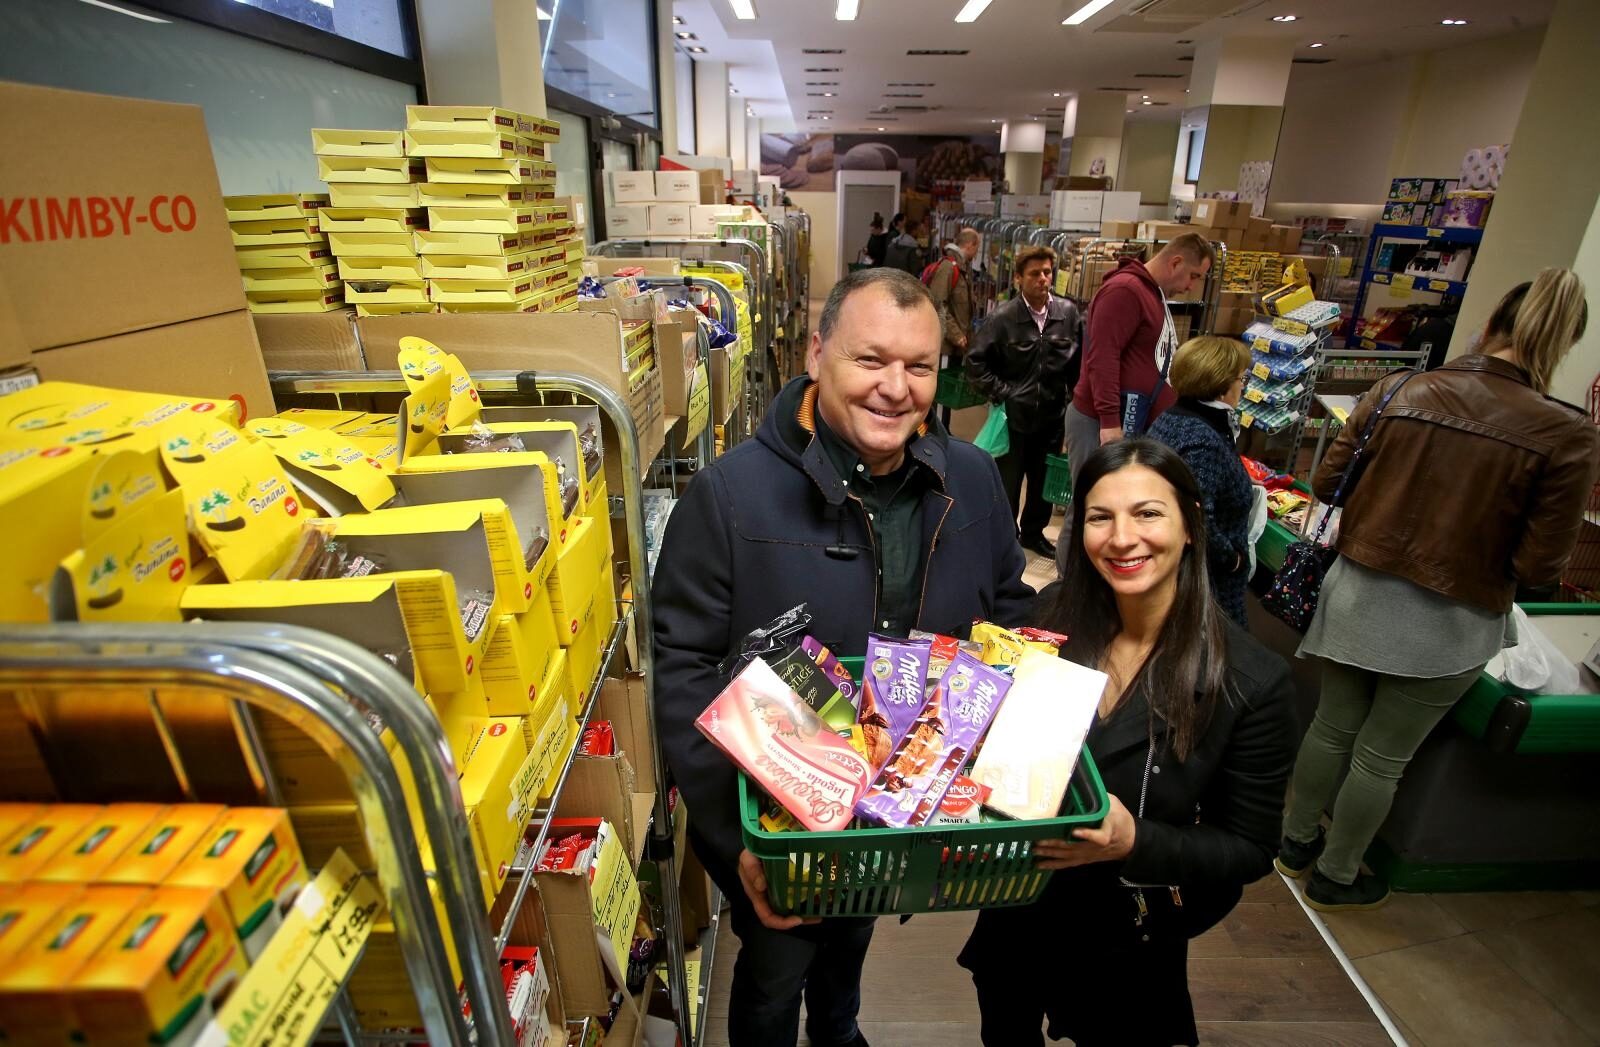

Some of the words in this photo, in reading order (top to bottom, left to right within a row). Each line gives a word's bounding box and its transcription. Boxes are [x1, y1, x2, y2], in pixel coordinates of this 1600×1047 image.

[0, 194, 197, 244] KIMBY-CO
[248, 484, 288, 514] Banana
[133, 545, 180, 583] Banana
[789, 664, 814, 690] STIGE
[897, 652, 921, 708] Milka
[971, 678, 998, 727] Milka
[755, 753, 845, 824] Praline
[806, 772, 849, 800] Jagoda
